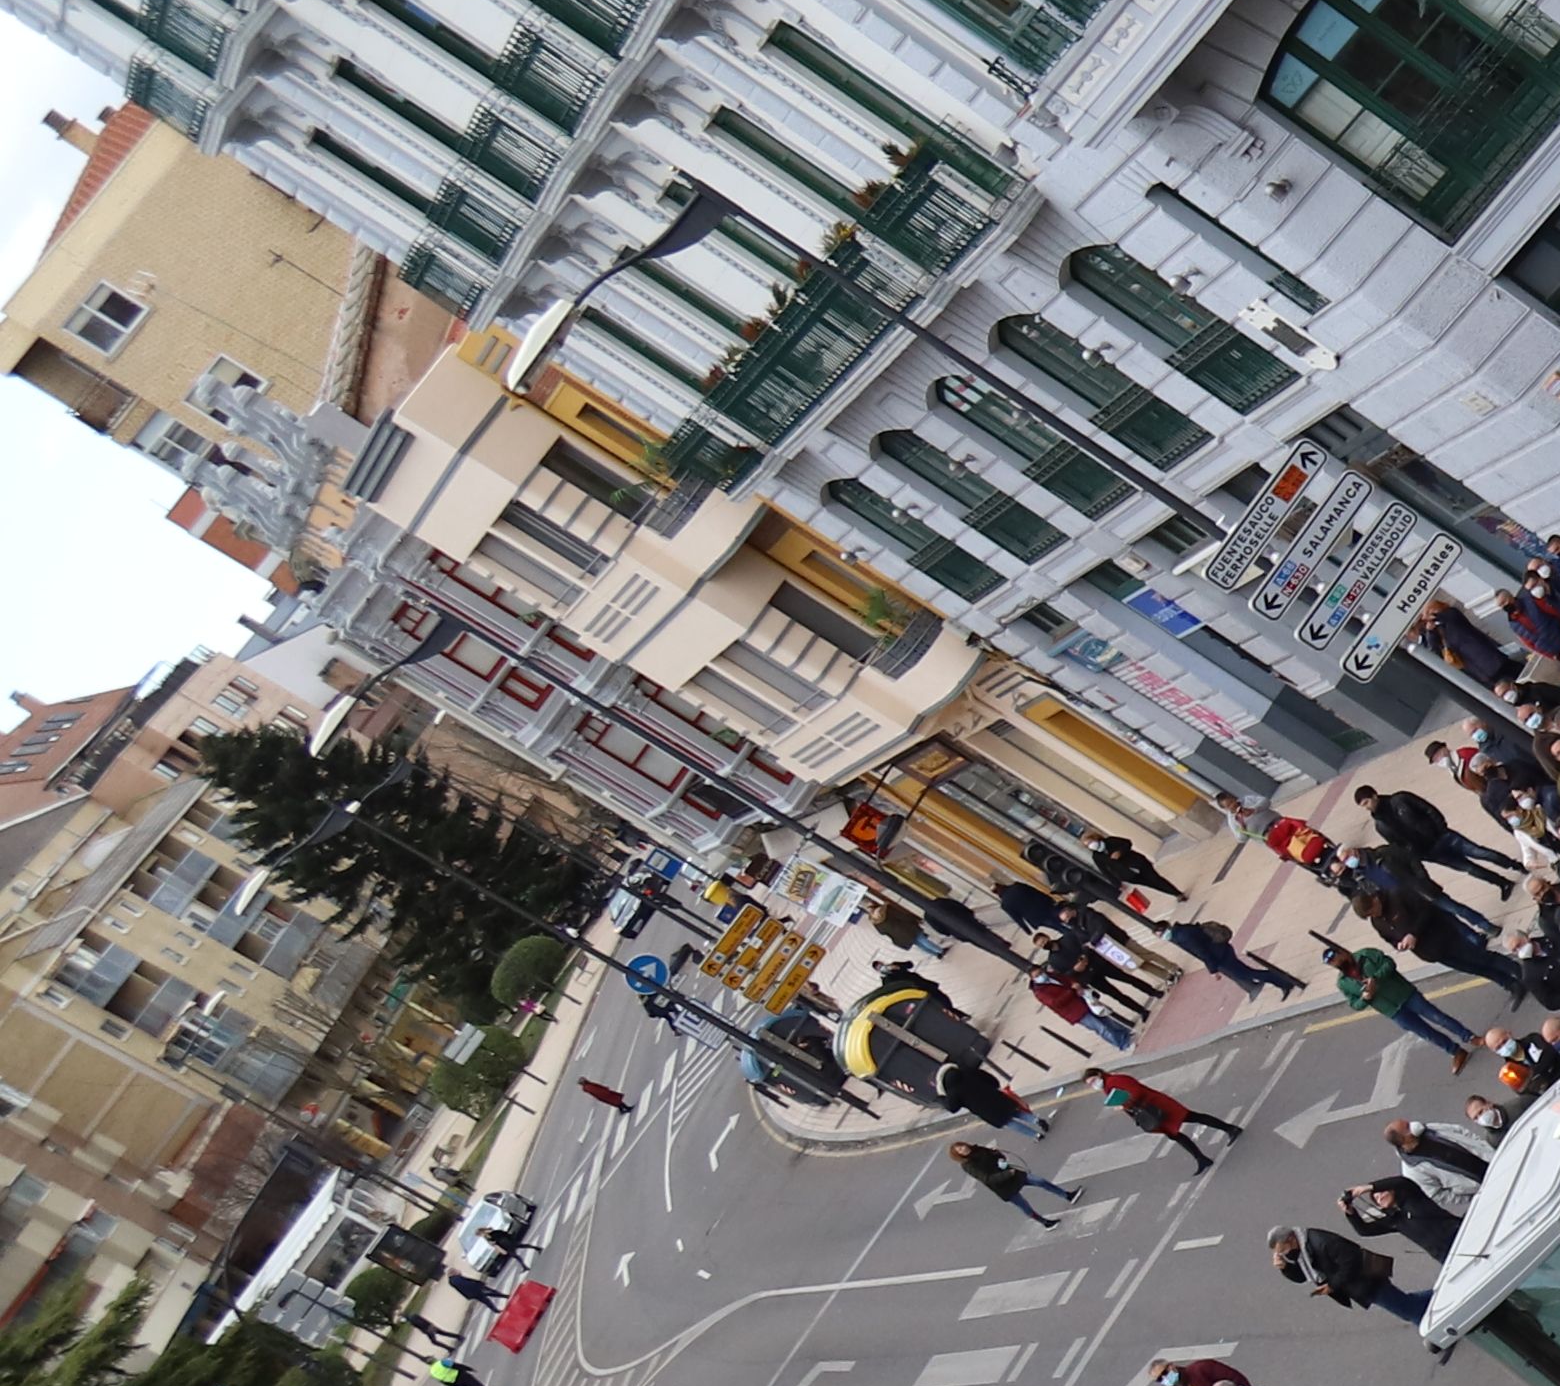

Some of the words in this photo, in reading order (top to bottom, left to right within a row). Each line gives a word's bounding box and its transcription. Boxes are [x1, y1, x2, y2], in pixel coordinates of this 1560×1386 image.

[1210, 495, 1276, 579] FUENTESAUCO
[1221, 512, 1279, 586] FERMOSELLE
[1283, 564, 1309, 598] N-630
[1302, 480, 1364, 558] SALAMANCA
[1343, 580, 1365, 609] N-122
[1361, 513, 1413, 582] VALLADOLID
[1351, 507, 1404, 573] TORDESILLAS
[1396, 541, 1455, 614] Hospitales
